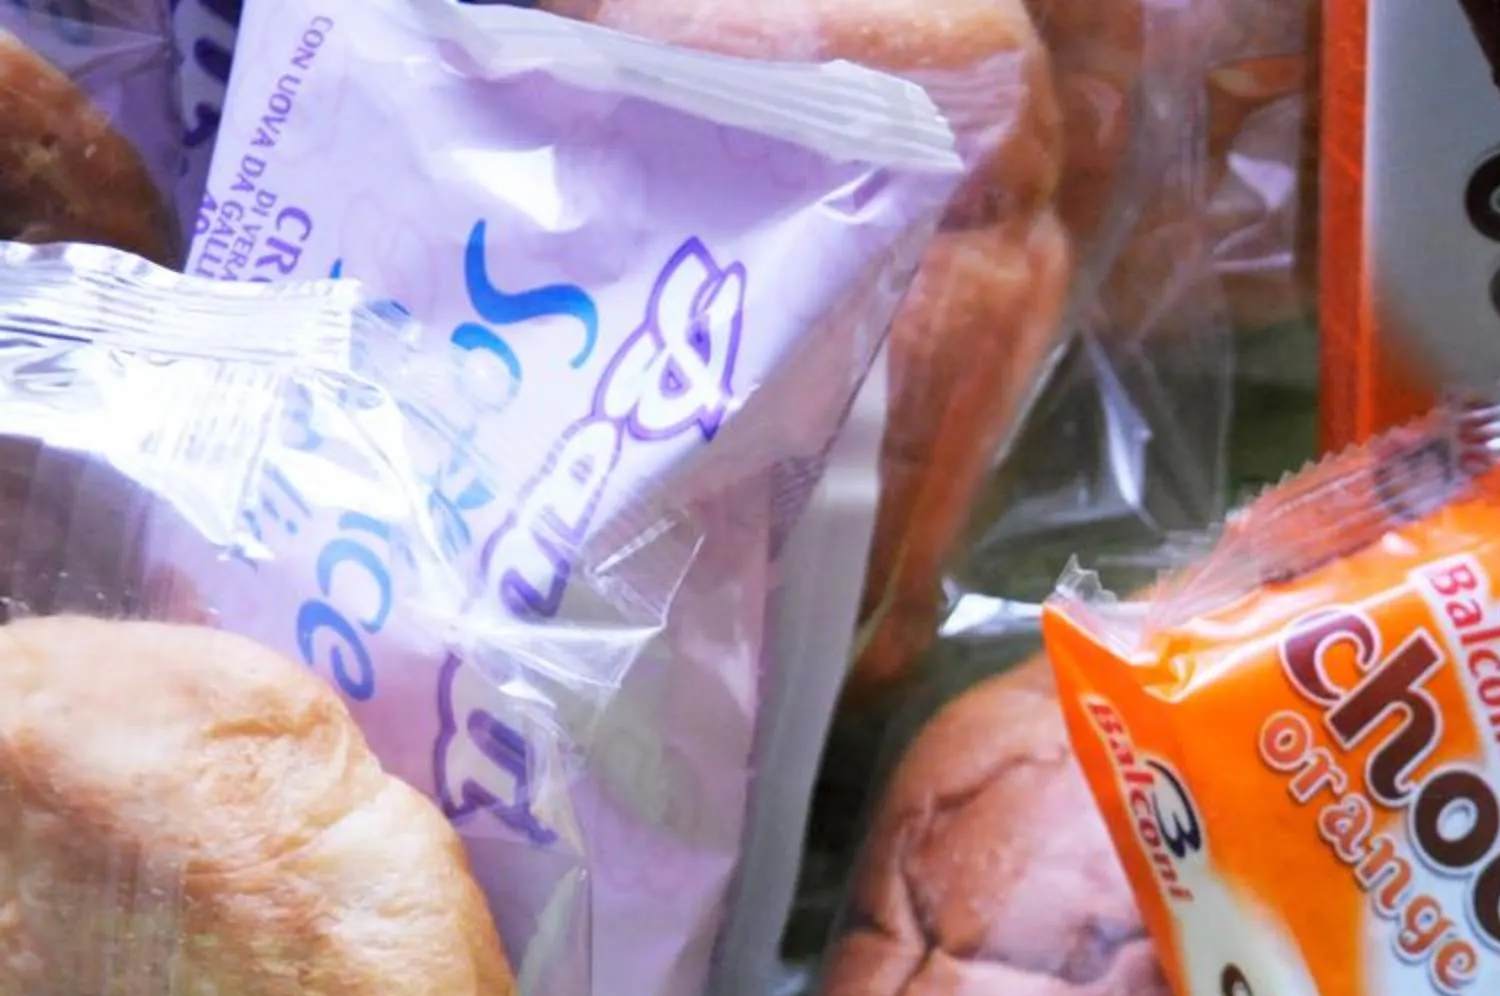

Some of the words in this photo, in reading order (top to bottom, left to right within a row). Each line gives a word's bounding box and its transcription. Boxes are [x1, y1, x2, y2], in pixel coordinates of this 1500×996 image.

[290, 15, 334, 70] CON
[250, 73, 302, 149] UOVA
[230, 154, 267, 192] DA
[249, 189, 278, 217] DI
[253, 206, 313, 283] CR
[1087, 701, 1195, 903] Balconi
[1260, 711, 1480, 995] orange
